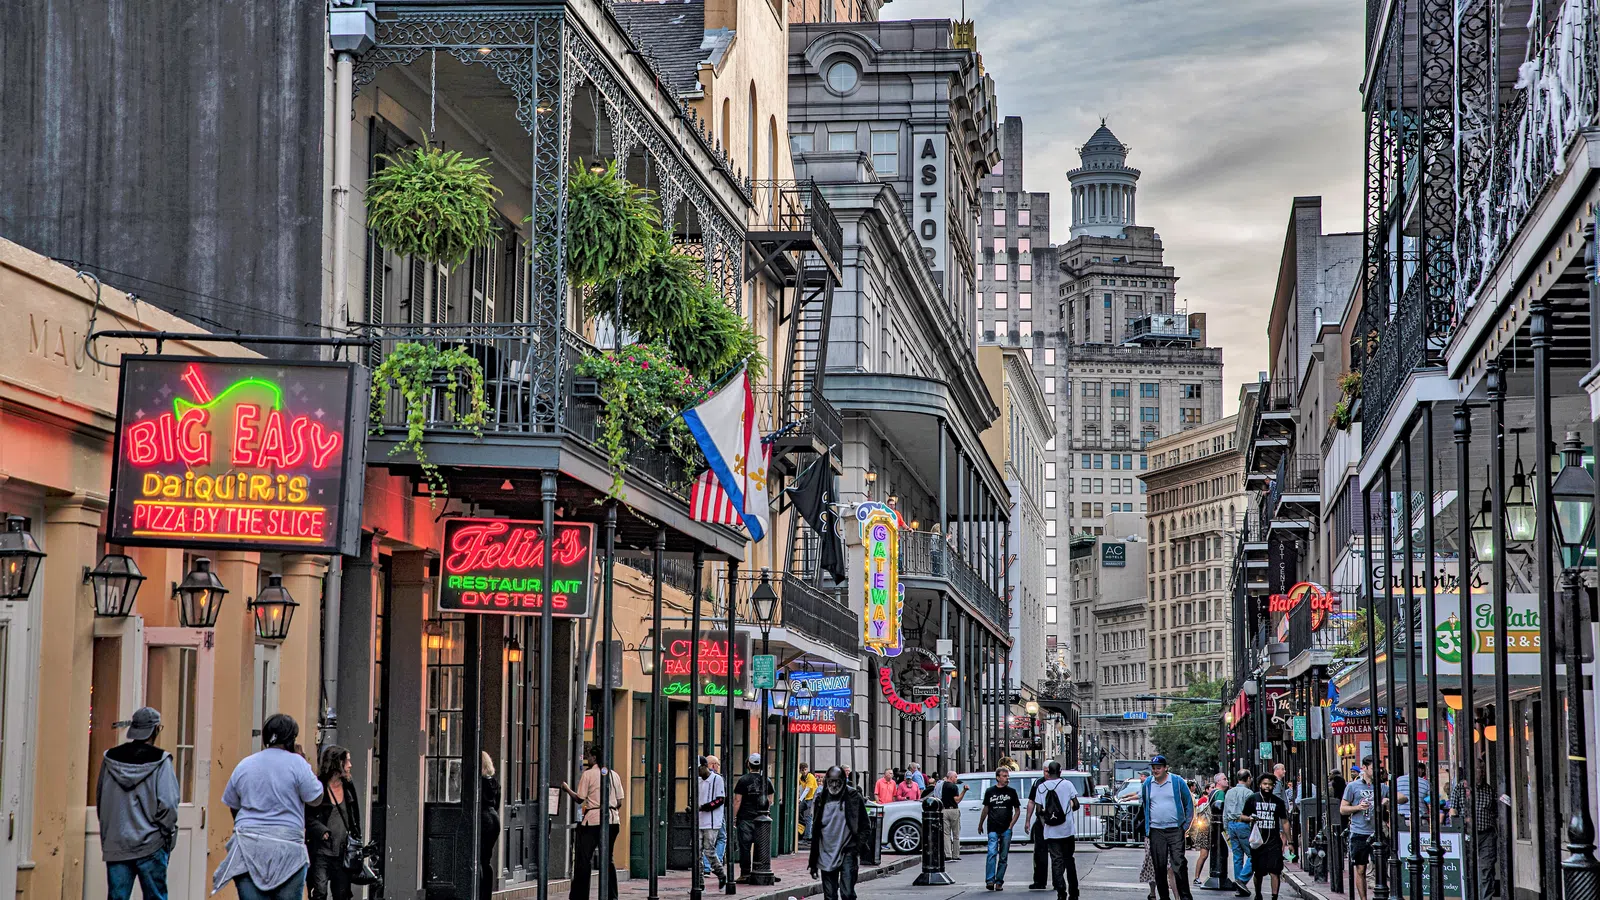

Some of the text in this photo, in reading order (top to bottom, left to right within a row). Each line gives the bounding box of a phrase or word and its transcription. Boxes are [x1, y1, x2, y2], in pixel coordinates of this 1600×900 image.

[920, 138, 937, 267] ASTOR
[128, 402, 342, 469] BIG EASY
[133, 504, 323, 537] PIZZA BY THE SLICE
[446, 522, 587, 573] Felix's
[1105, 546, 1123, 555] AC
[871, 525, 888, 637] GATEWAY
[1310, 591, 1334, 612] ock
[1485, 635, 1516, 647] BR
[1519, 635, 1530, 647] &
[816, 697, 850, 708] COCKTAILS
[880, 667, 922, 714] BOURBON
[1255, 802, 1277, 811] AWW
[1256, 811, 1275, 820] HELL
